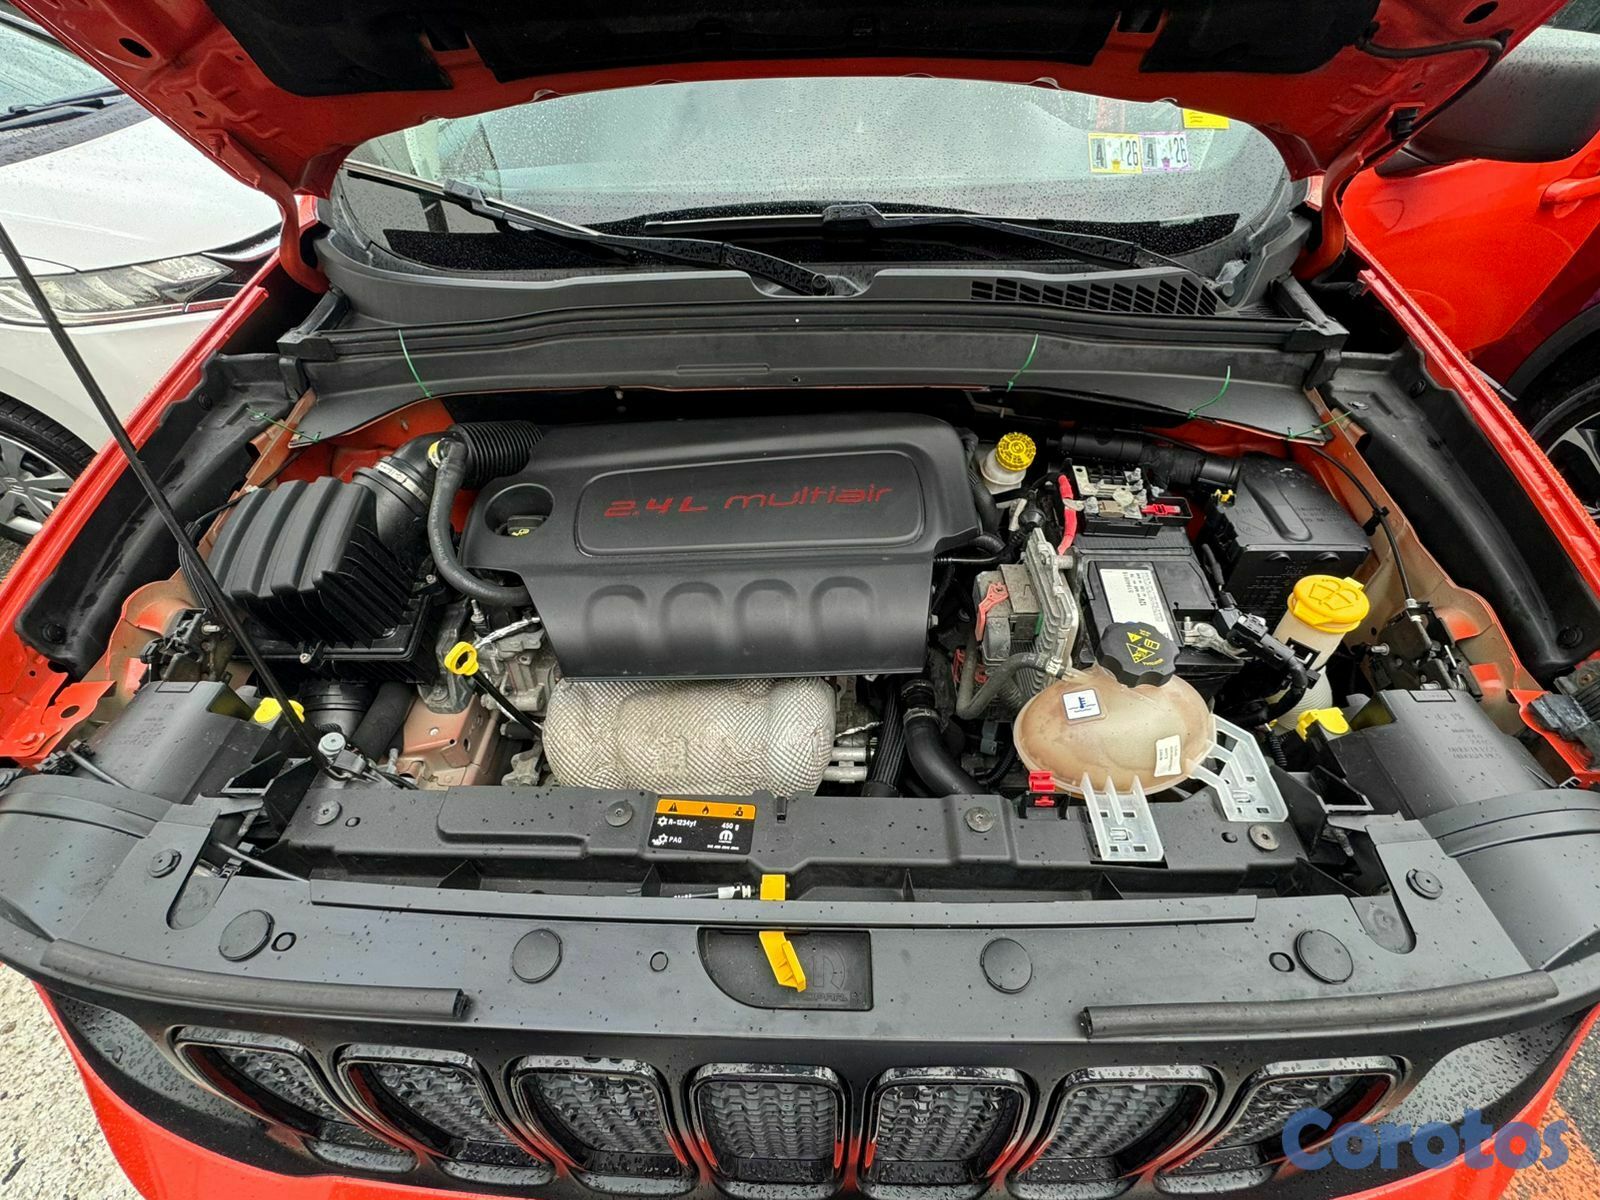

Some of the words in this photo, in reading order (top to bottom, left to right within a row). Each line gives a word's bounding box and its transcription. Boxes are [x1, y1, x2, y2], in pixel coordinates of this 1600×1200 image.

[1125, 140, 1139, 166] 26
[1173, 137, 1187, 163] 26
[723, 483, 893, 509] multiair
[668, 836, 682, 844] PAG
